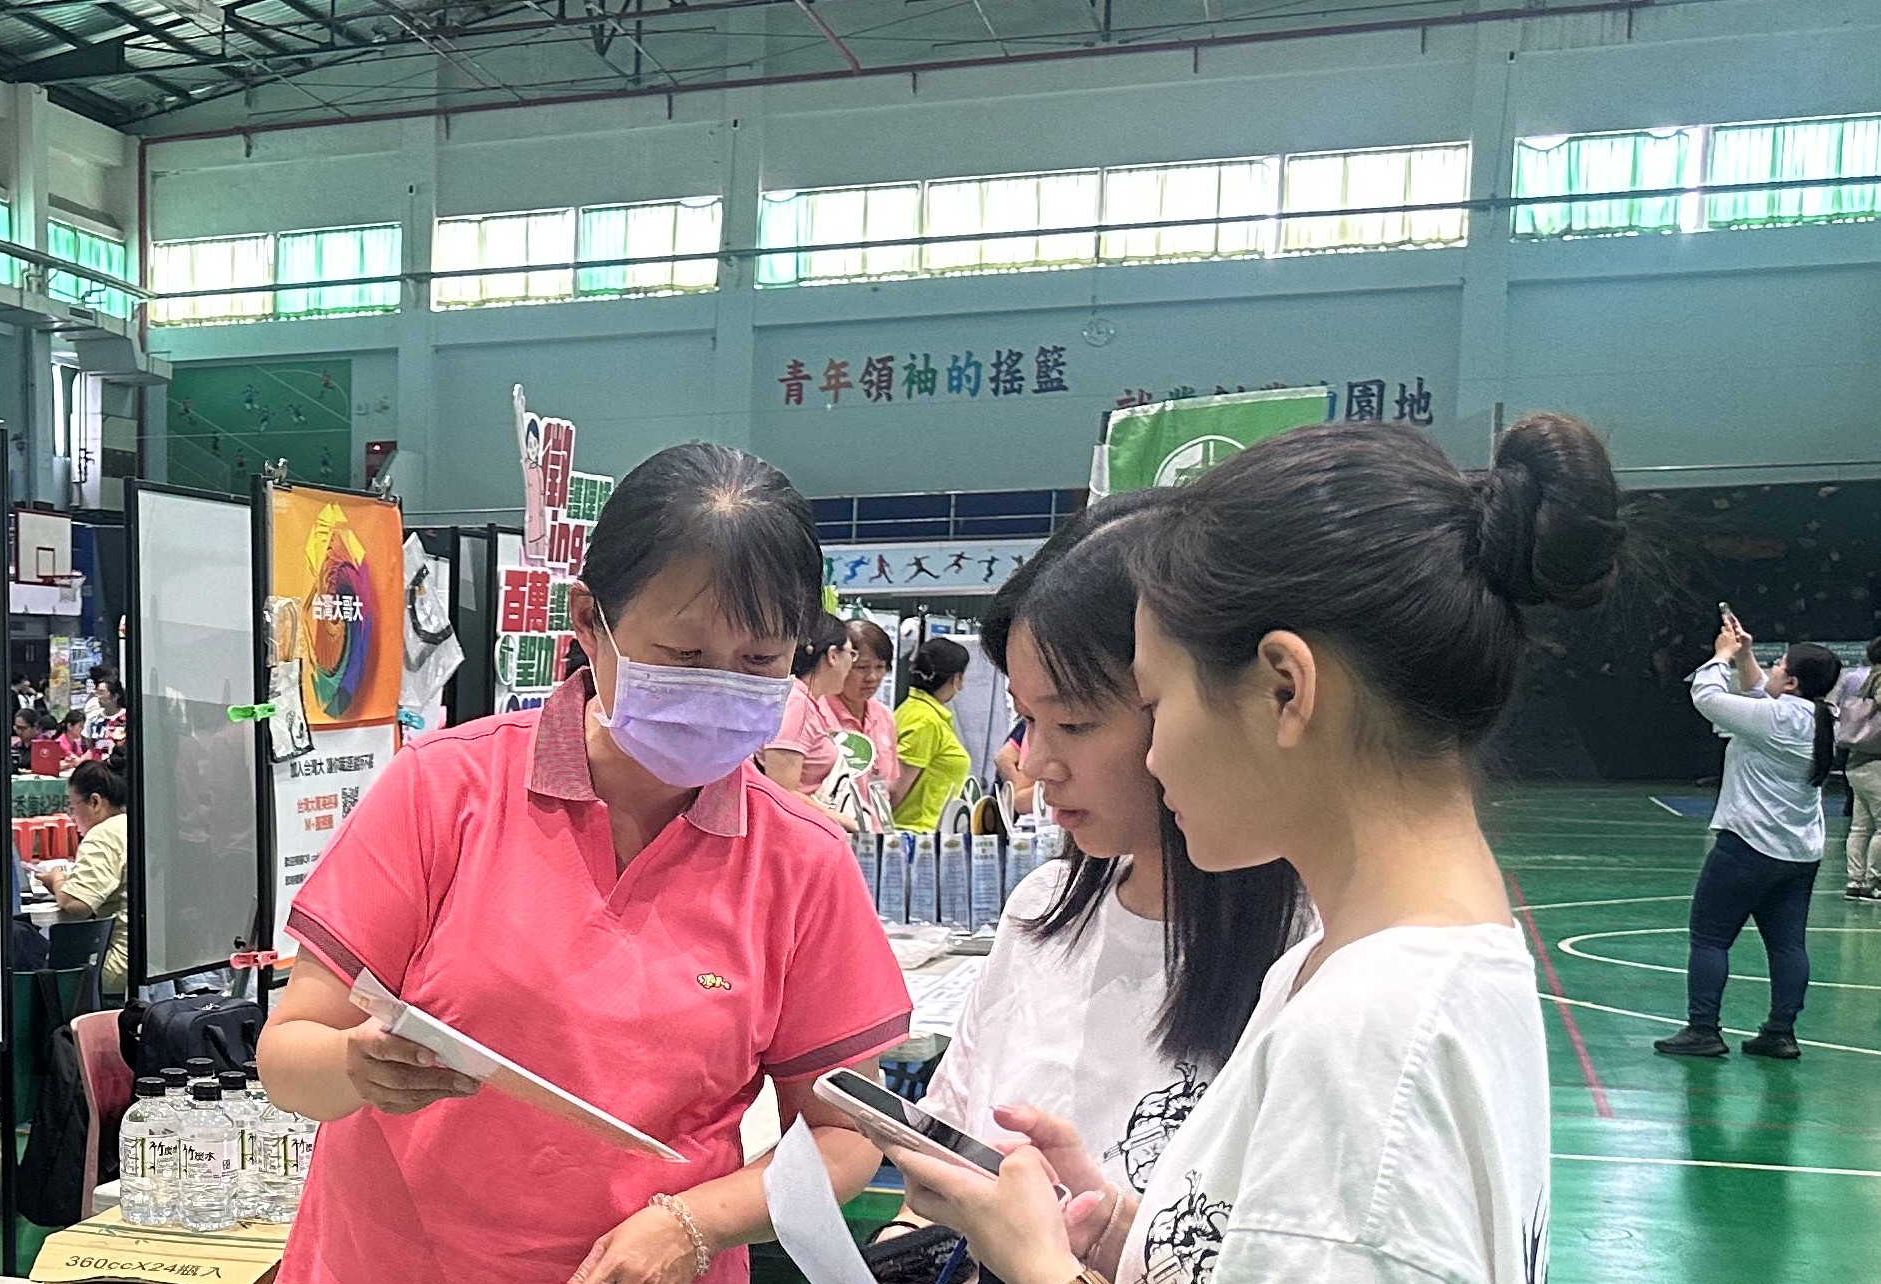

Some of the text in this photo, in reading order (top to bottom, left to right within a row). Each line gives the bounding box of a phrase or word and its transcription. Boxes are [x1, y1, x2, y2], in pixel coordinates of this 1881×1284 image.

[777, 345, 1069, 406] 青年領袖的搖籃
[312, 593, 364, 622] 台灣大哥大
